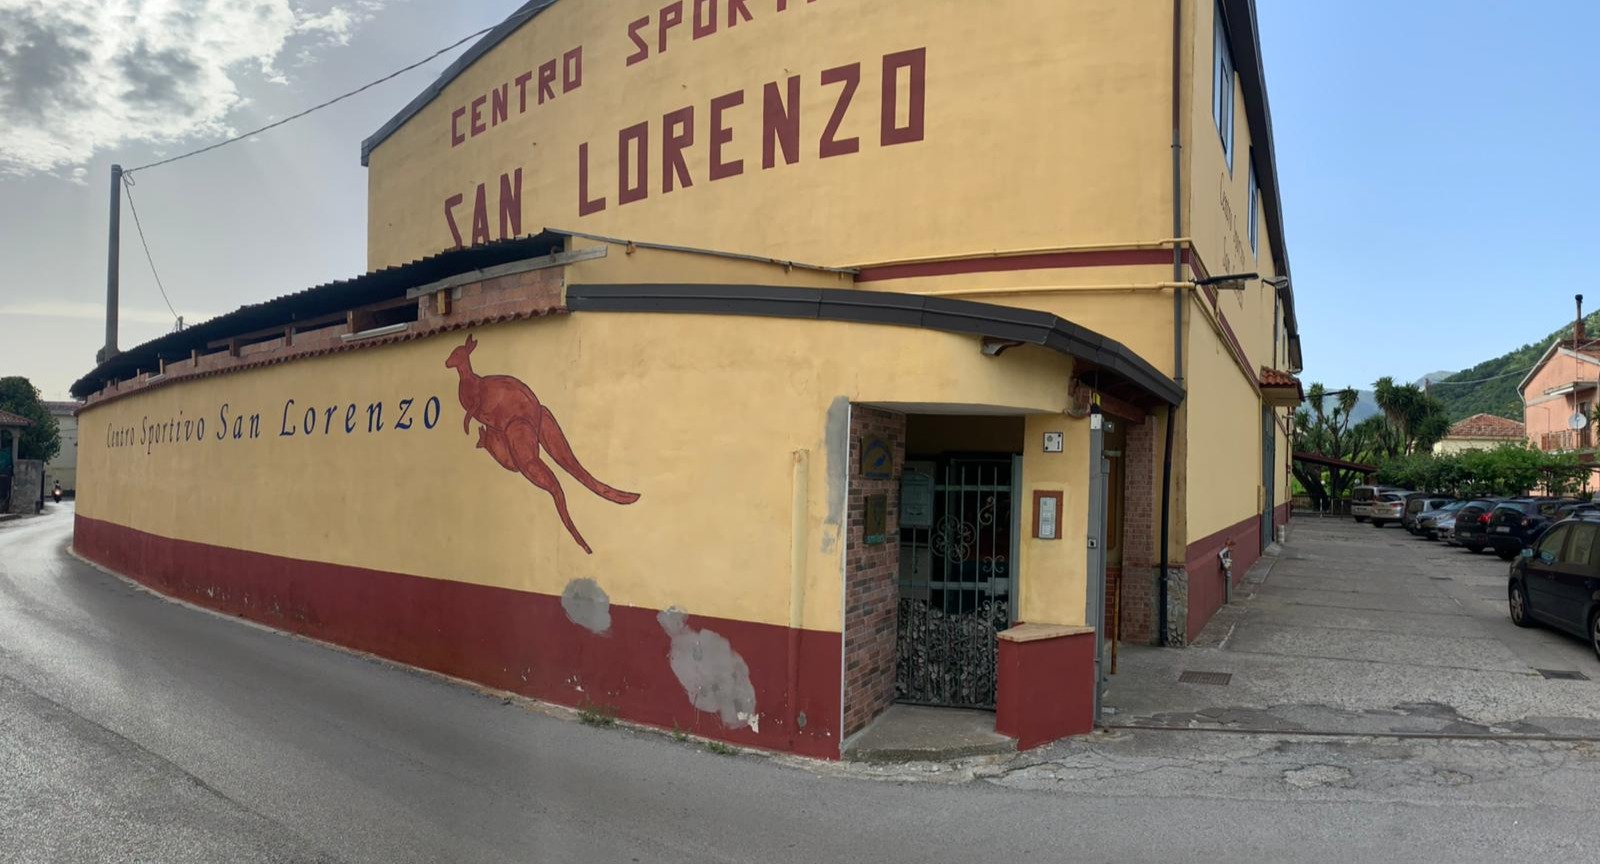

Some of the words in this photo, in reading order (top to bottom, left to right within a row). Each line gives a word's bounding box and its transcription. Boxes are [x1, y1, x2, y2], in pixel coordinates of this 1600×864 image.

[451, 45, 582, 148] CENTRO
[626, 0, 817, 67] SPOR
[444, 167, 522, 250] SAN
[578, 47, 926, 217] LORENZO
[106, 422, 135, 449] Centro
[140, 410, 206, 455] Sportivo
[216, 403, 261, 441] San
[279, 396, 441, 437] Lorenzo
